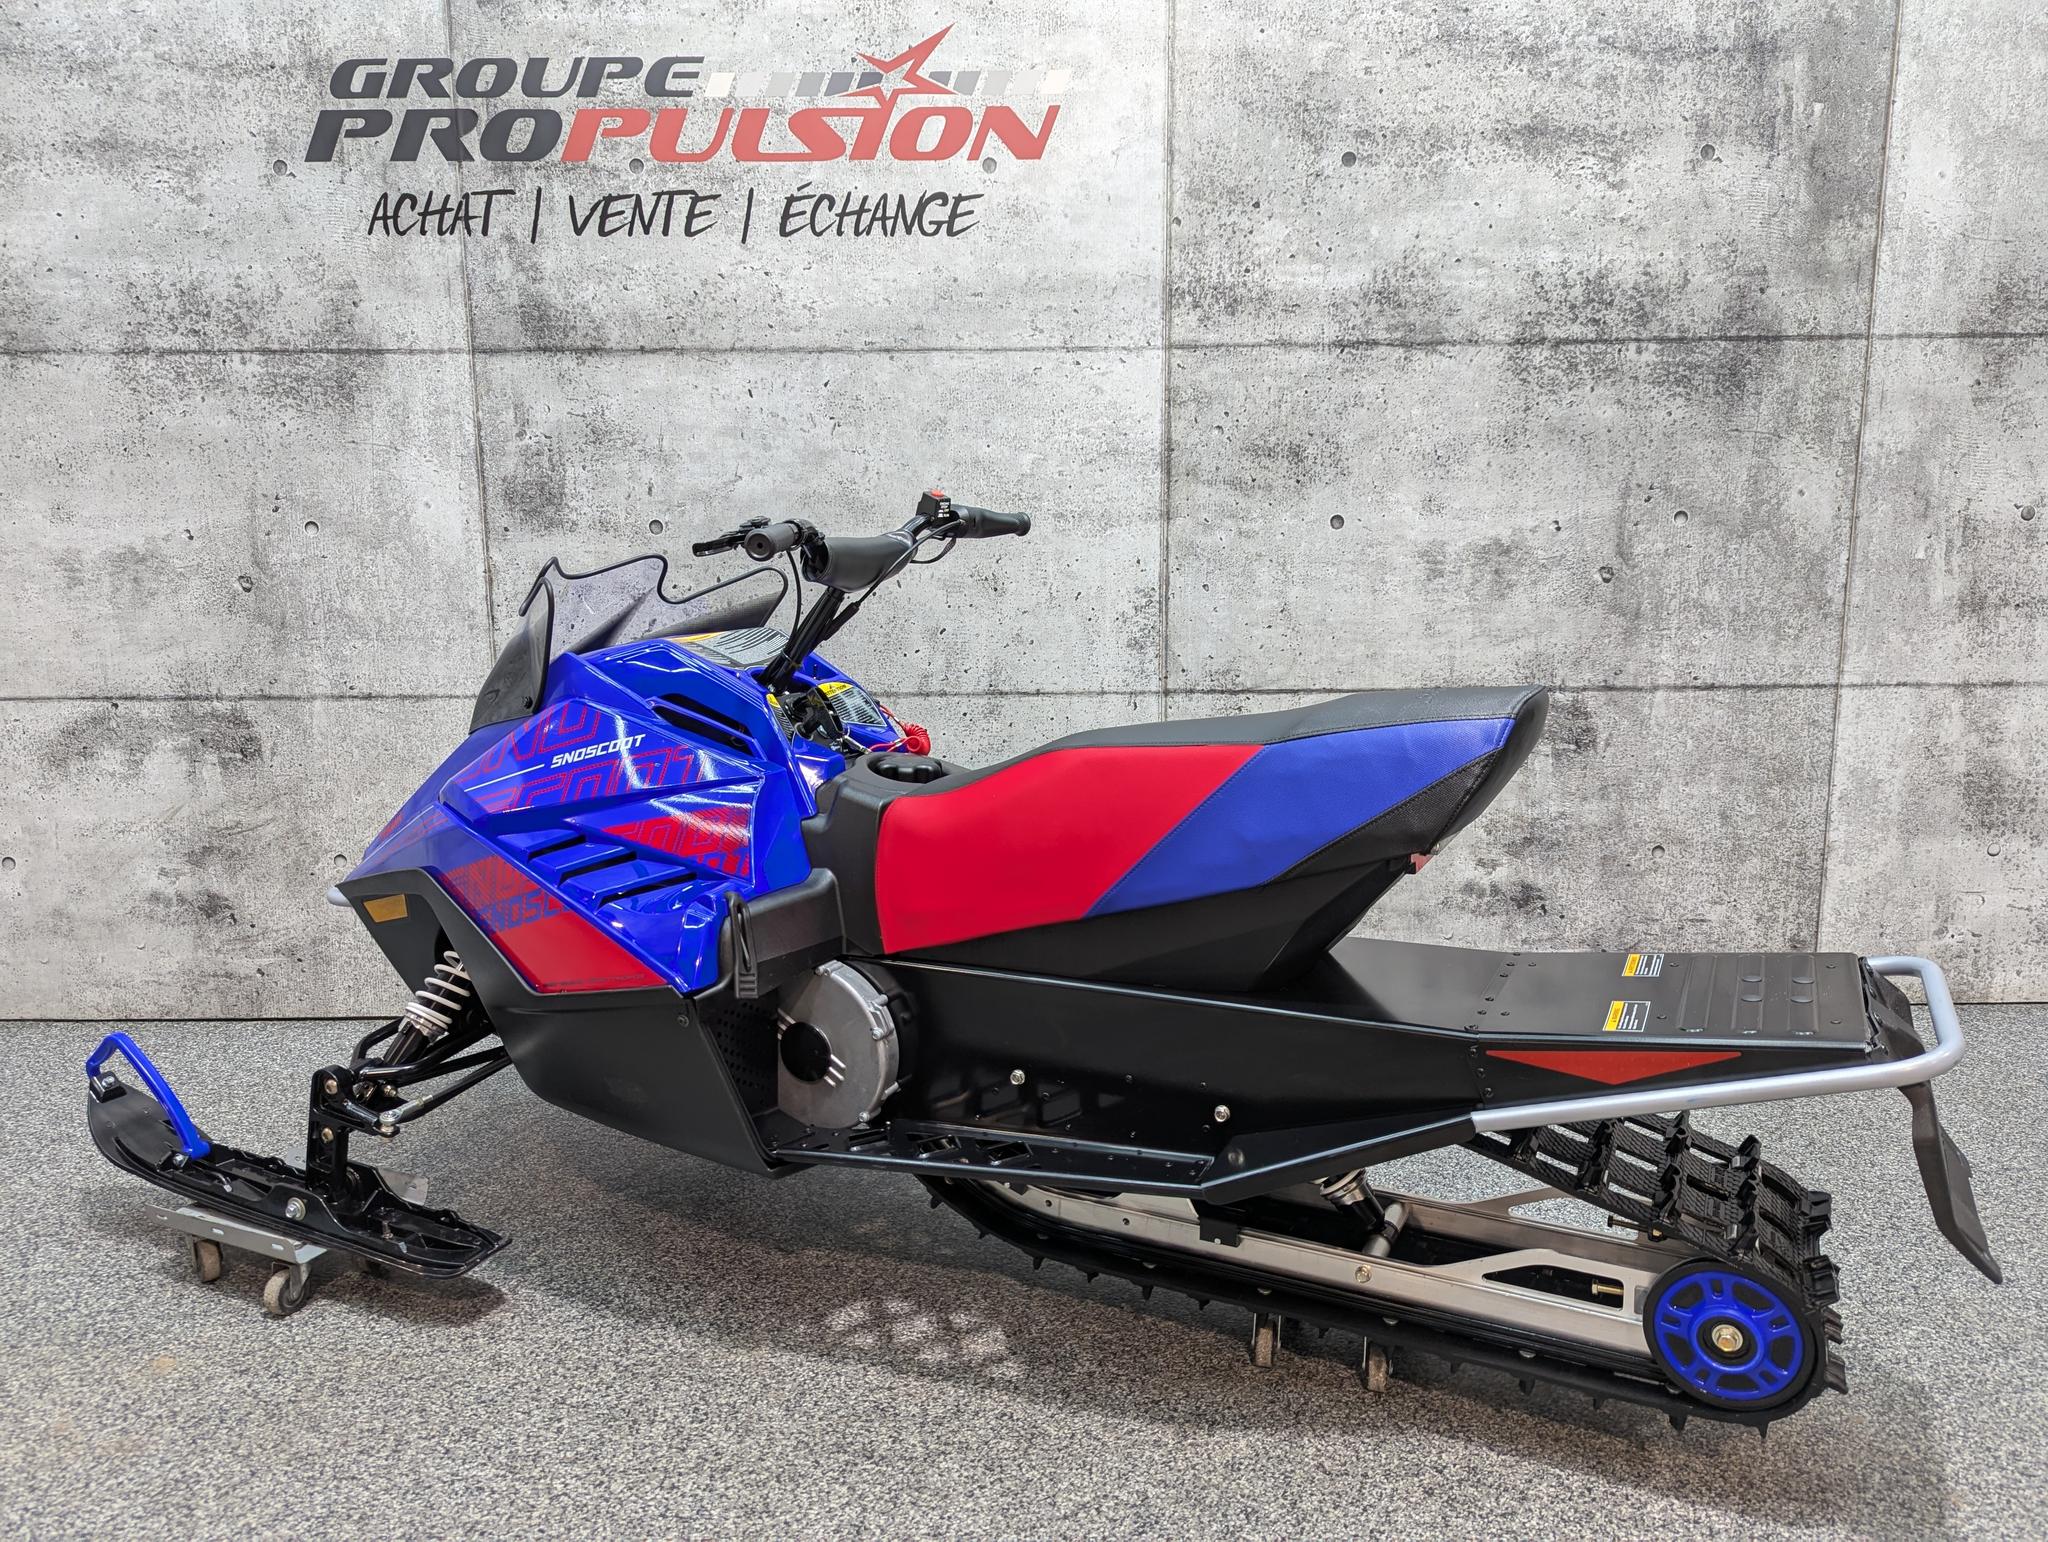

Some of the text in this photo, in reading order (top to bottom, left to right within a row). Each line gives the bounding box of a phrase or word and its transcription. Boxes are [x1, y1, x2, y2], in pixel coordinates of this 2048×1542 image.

[329, 57, 704, 100] GROUPE
[304, 107, 1060, 164] PROPULSION
[367, 191, 517, 237] ACHAT
[568, 189, 722, 238] VENTE
[779, 182, 985, 238] ÉCHANGE
[550, 733, 647, 769] SNOSCOOT
